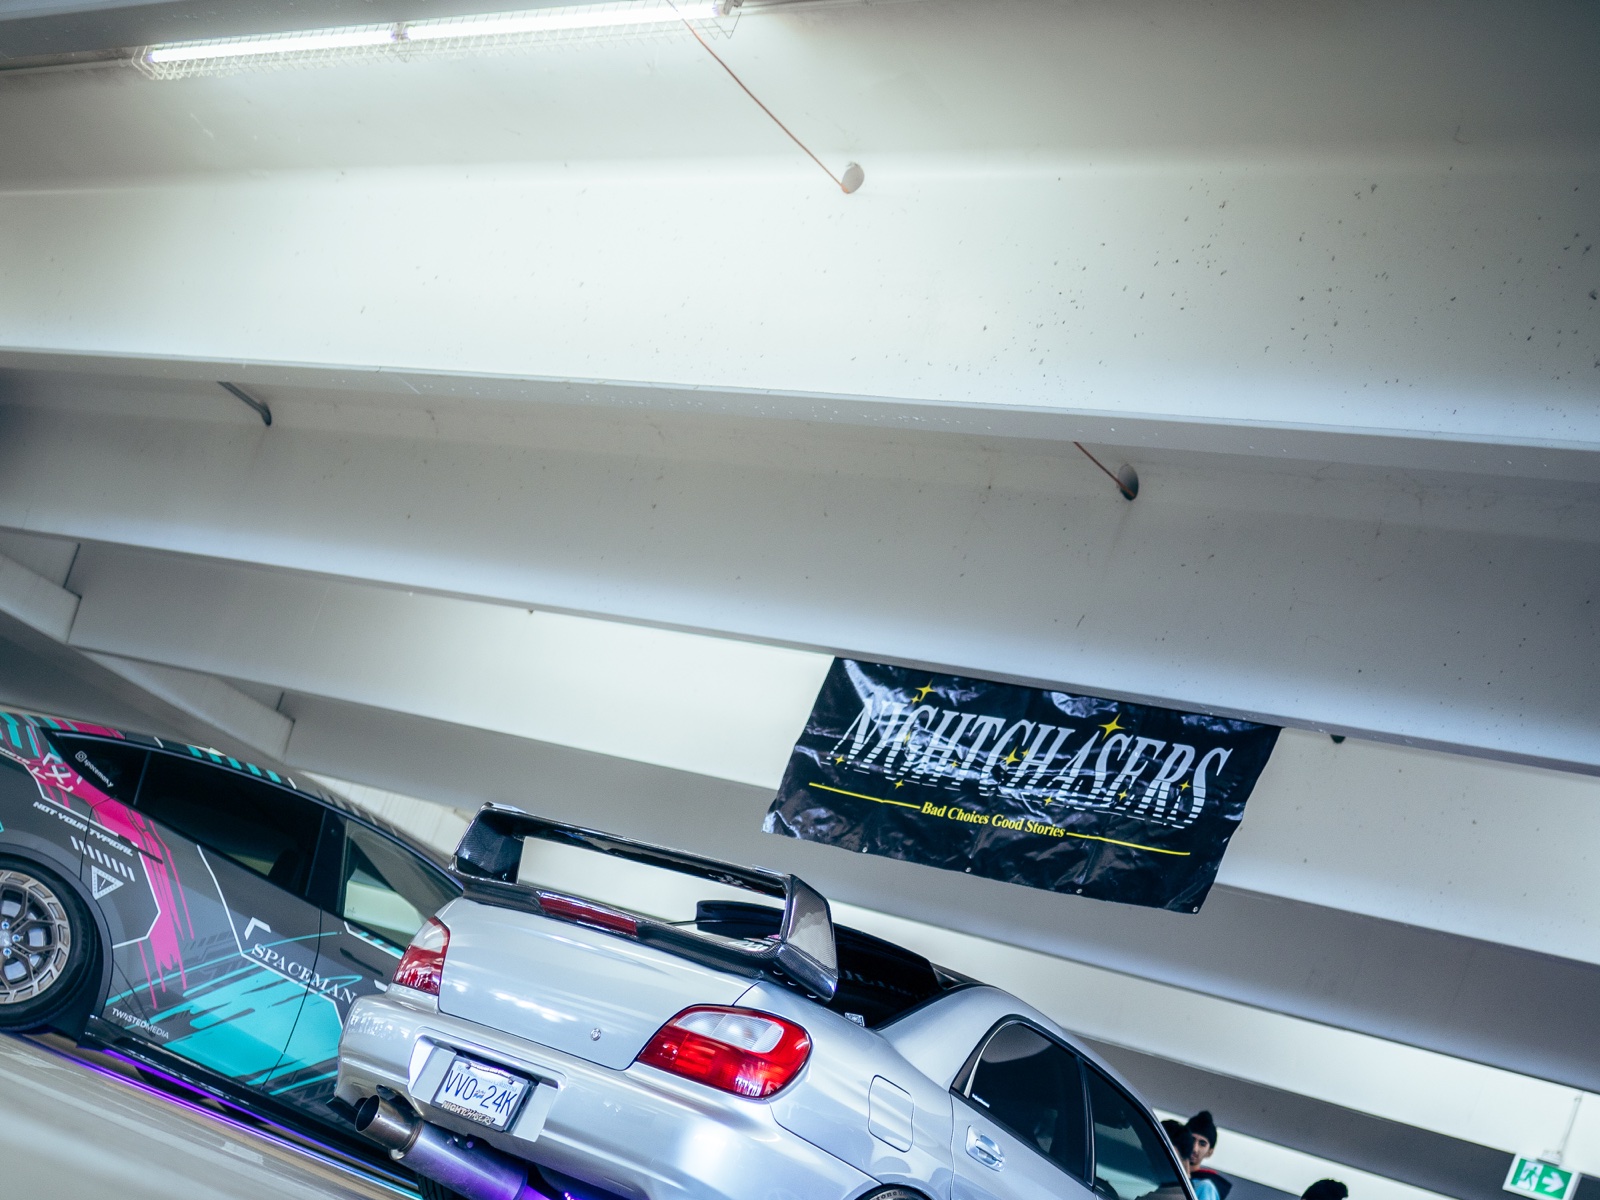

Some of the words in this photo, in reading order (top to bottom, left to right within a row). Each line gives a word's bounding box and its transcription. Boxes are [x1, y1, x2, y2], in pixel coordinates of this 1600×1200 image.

[826, 698, 1233, 829] NIGHTCHASERS
[33, 801, 57, 815] NOT
[58, 813, 88, 832] YOUR
[90, 828, 133, 857] TYPICAL
[921, 801, 947, 818] Bad
[947, 807, 989, 825] Choices
[992, 814, 1026, 831] Good
[1025, 820, 1066, 838] Stories
[252, 943, 357, 1004] SPACEMAN
[480, 1085, 518, 1117] 24K
